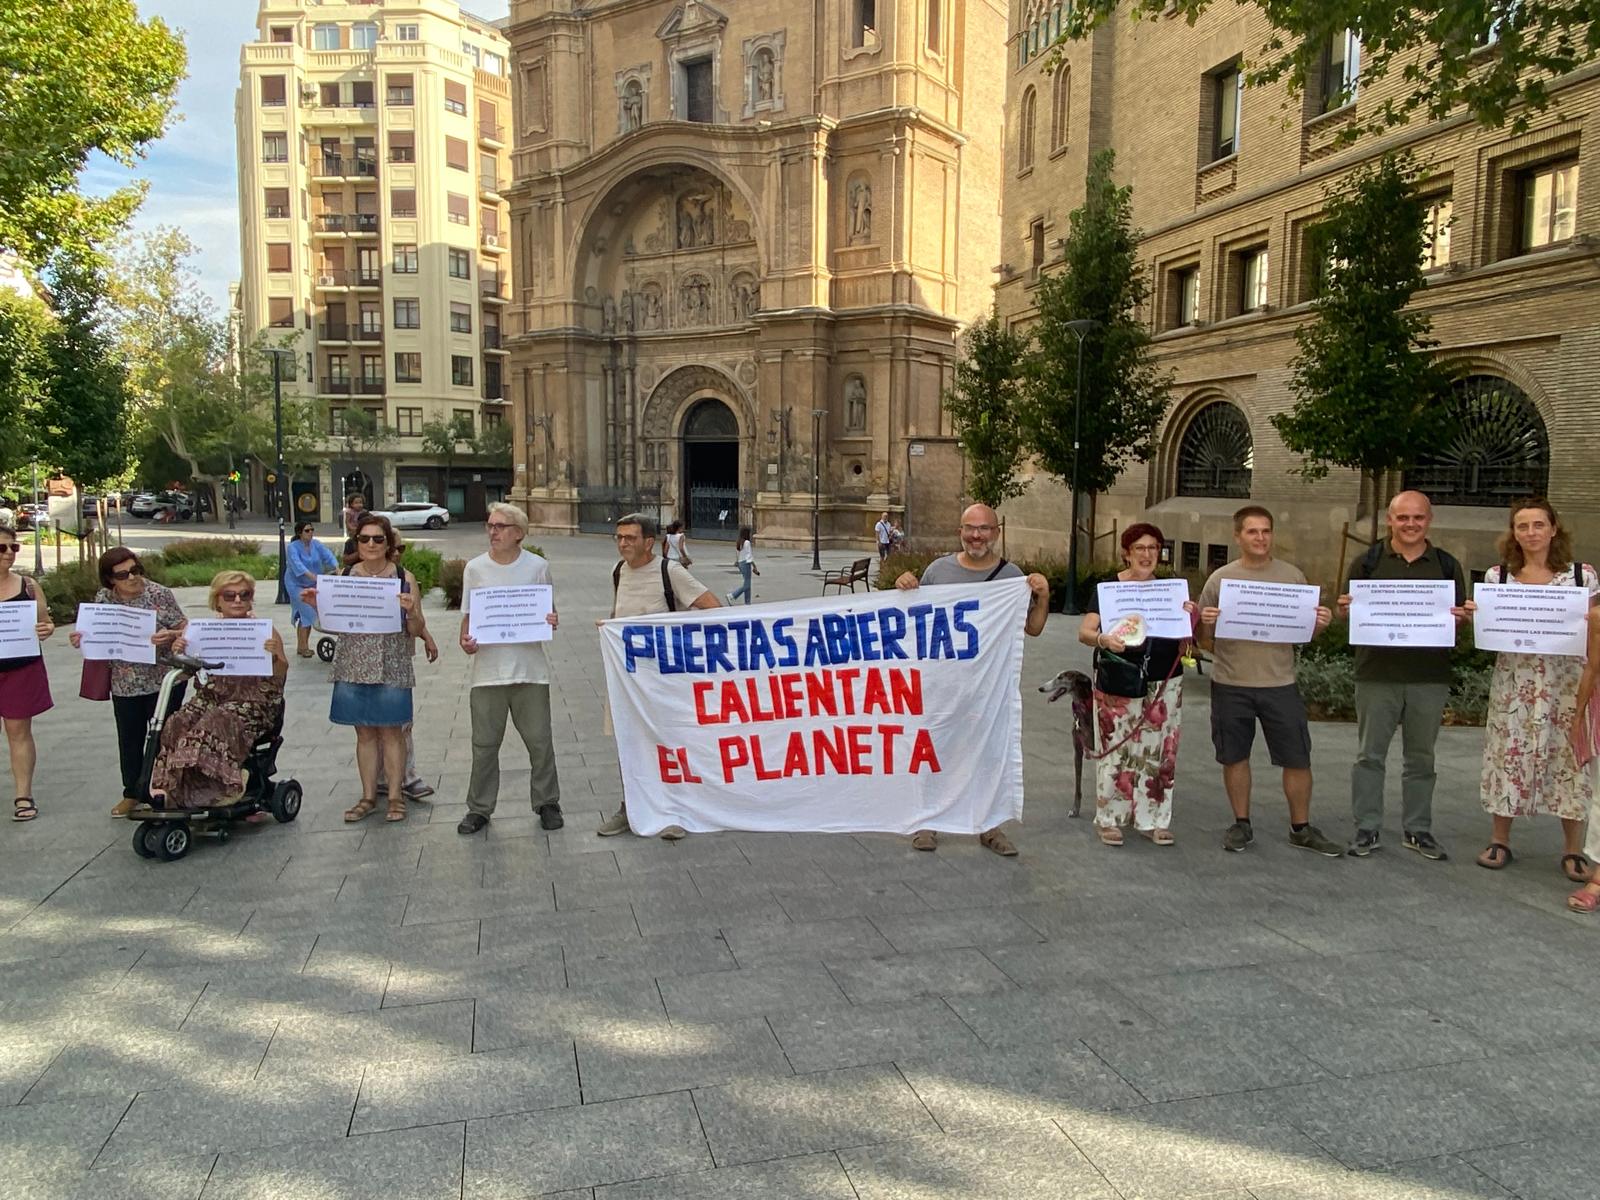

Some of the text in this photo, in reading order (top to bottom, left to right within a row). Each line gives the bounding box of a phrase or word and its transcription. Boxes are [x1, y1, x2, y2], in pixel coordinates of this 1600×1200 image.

[622, 600, 980, 674] PUERTAS ABIERTAS
[692, 667, 924, 725] CALIENTAN
[656, 725, 942, 784] EL PLANETA
